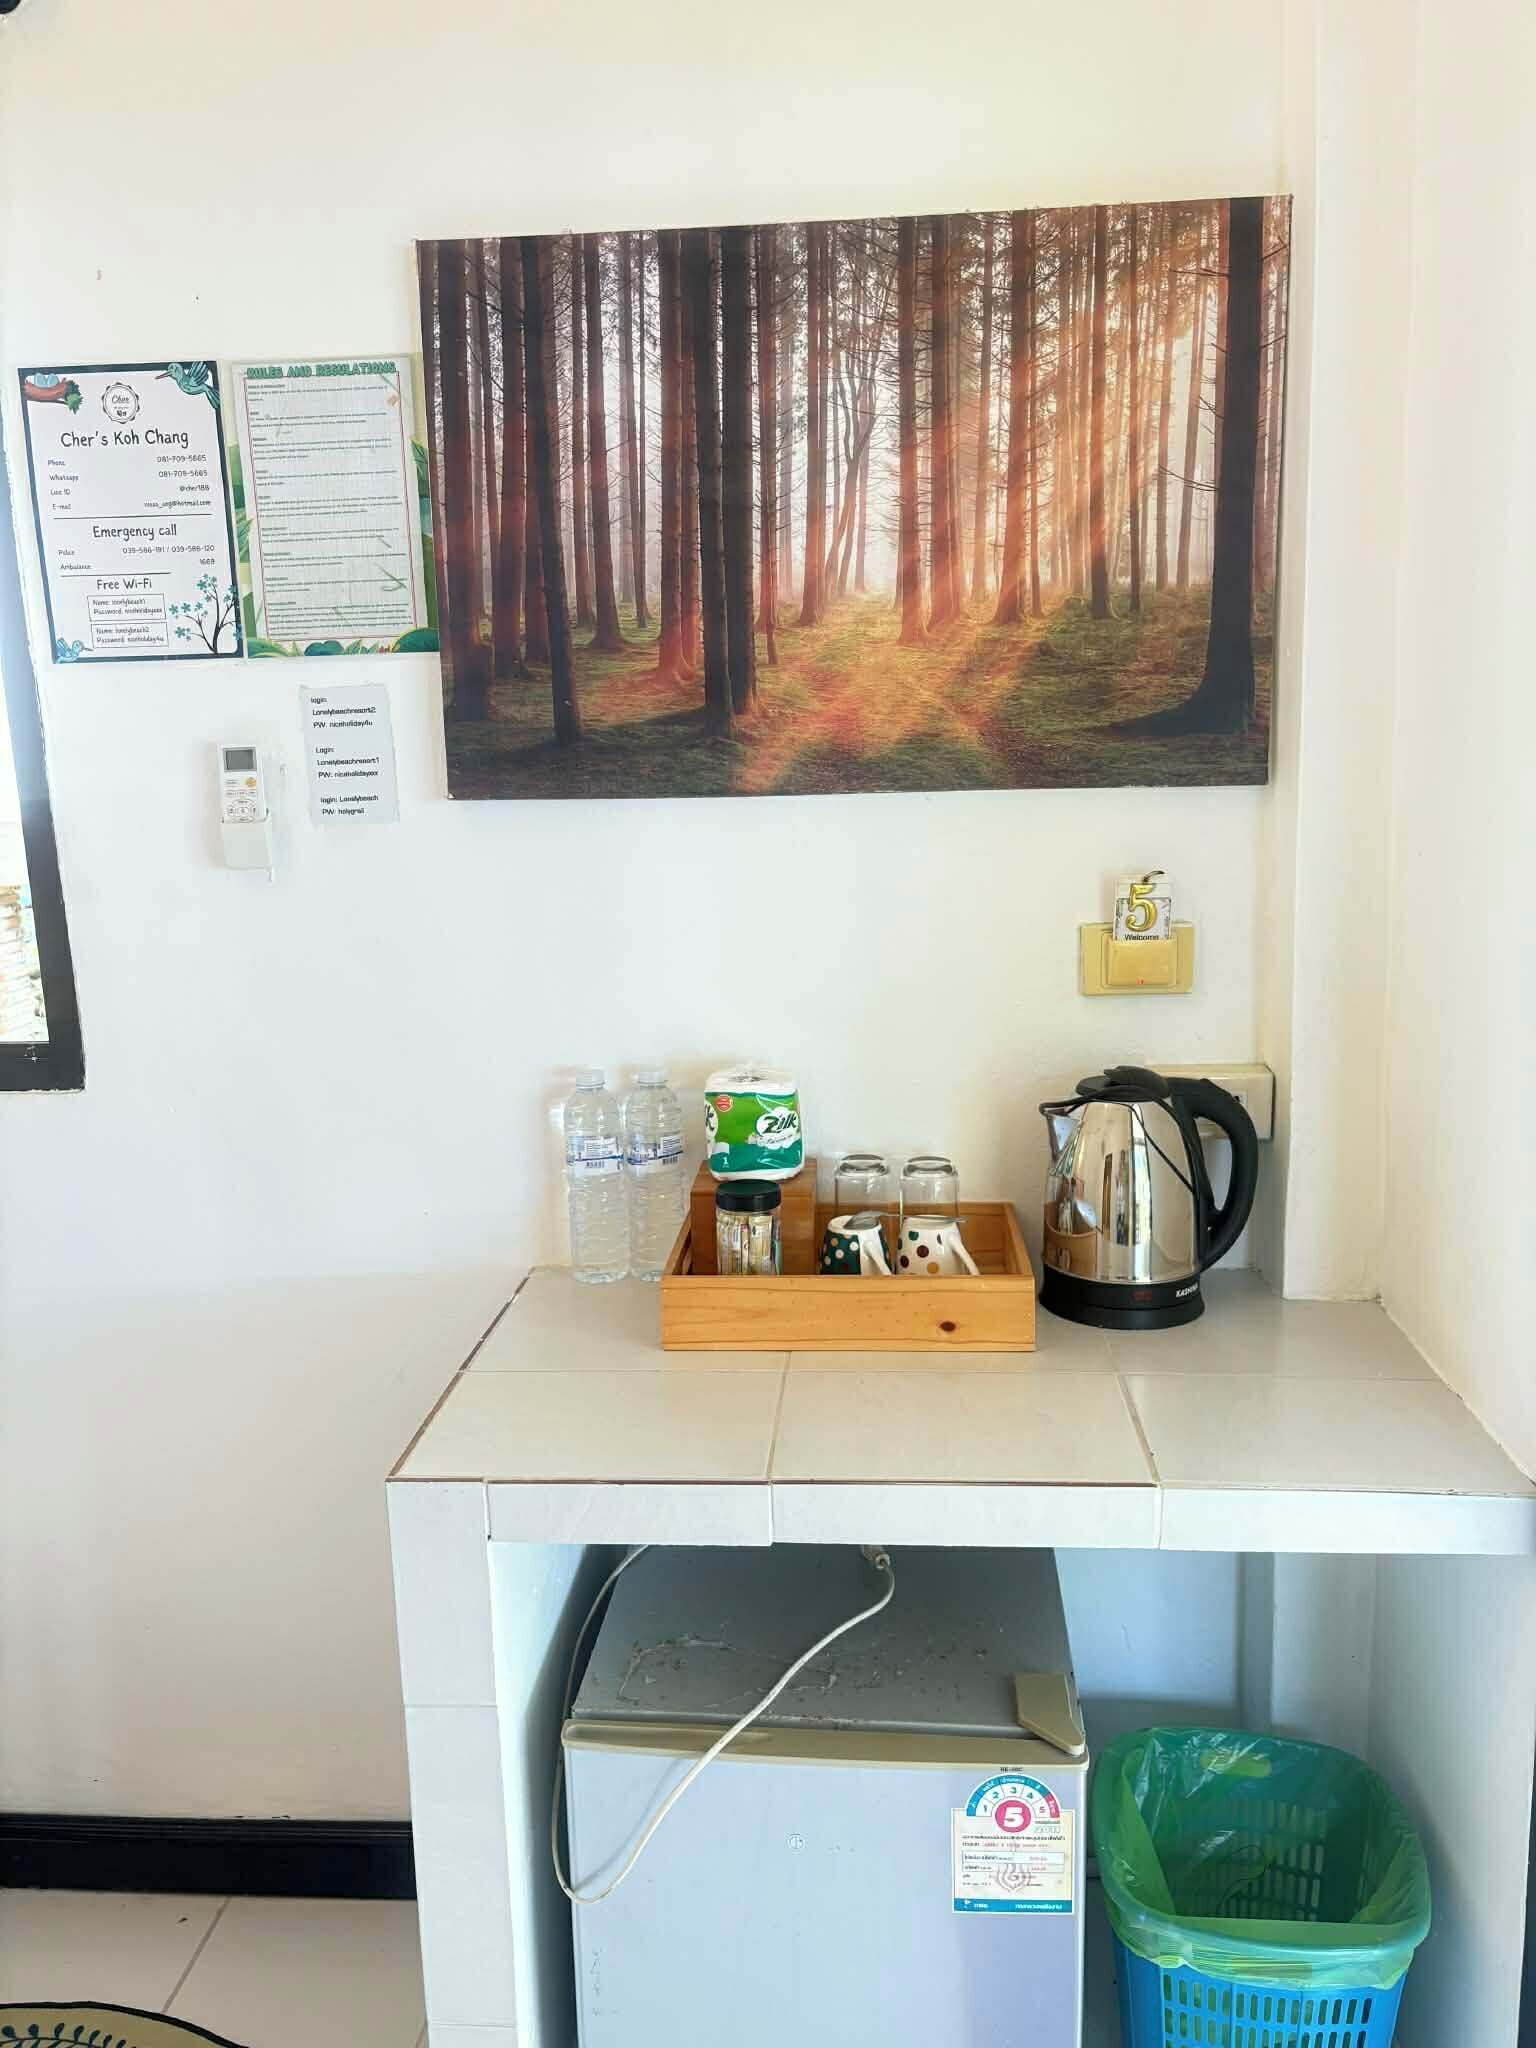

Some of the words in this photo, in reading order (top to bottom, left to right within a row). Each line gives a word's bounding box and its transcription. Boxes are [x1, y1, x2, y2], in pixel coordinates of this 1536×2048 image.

[60, 430, 109, 448] Cher's
[114, 429, 140, 446] Koh
[145, 427, 189, 450] Chang
[93, 526, 155, 542] Emergency
[159, 523, 178, 537] call
[96, 578, 120, 591] Free
[123, 577, 153, 590] Wi-Fi
[1126, 884, 1158, 932] 5
[762, 1112, 797, 1134] Zilk
[1003, 1807, 1025, 1828] 5
